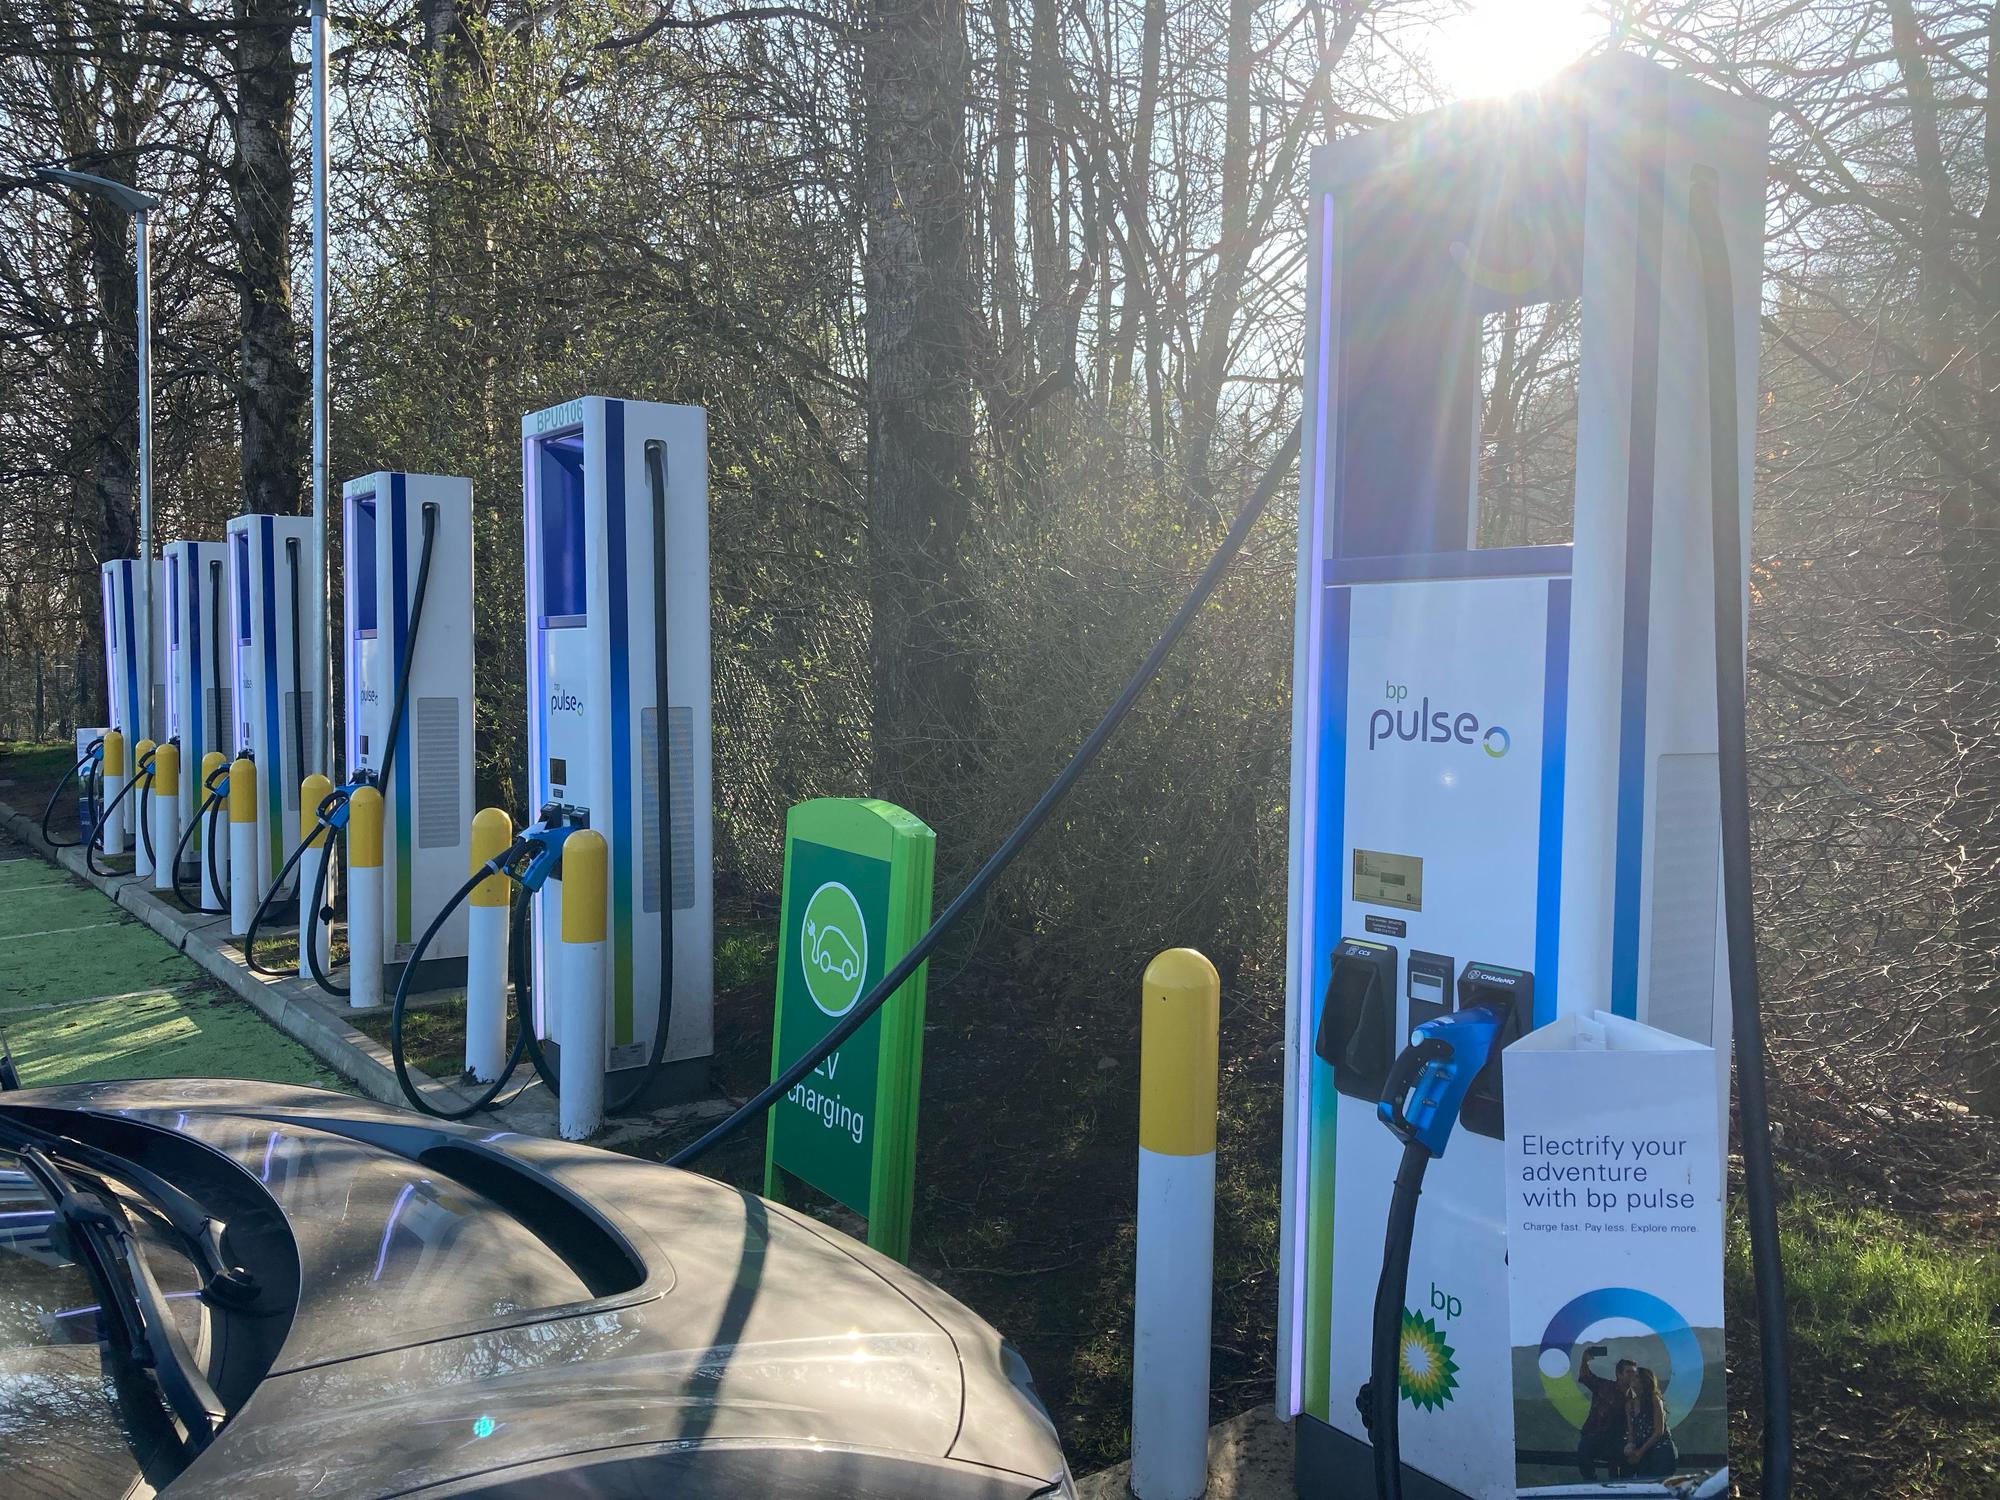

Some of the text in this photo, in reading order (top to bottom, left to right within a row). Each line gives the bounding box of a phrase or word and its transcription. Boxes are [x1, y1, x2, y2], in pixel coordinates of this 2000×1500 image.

[537, 400, 583, 432] BPU0106
[551, 689, 577, 716] pulse
[1385, 680, 1408, 704] bp
[1369, 697, 1479, 751] pulse
[1522, 1135, 1687, 1161] Electrify your
[1522, 1161, 1648, 1182] adventure
[1522, 1187, 1695, 1213] with bp pulse
[1522, 1221, 1558, 1233] Charge
[1584, 1222, 1602, 1233] Pay
[1604, 1223, 1628, 1233] less.
[1630, 1223, 1668, 1234] Explore
[1431, 1281, 1462, 1321] bp
